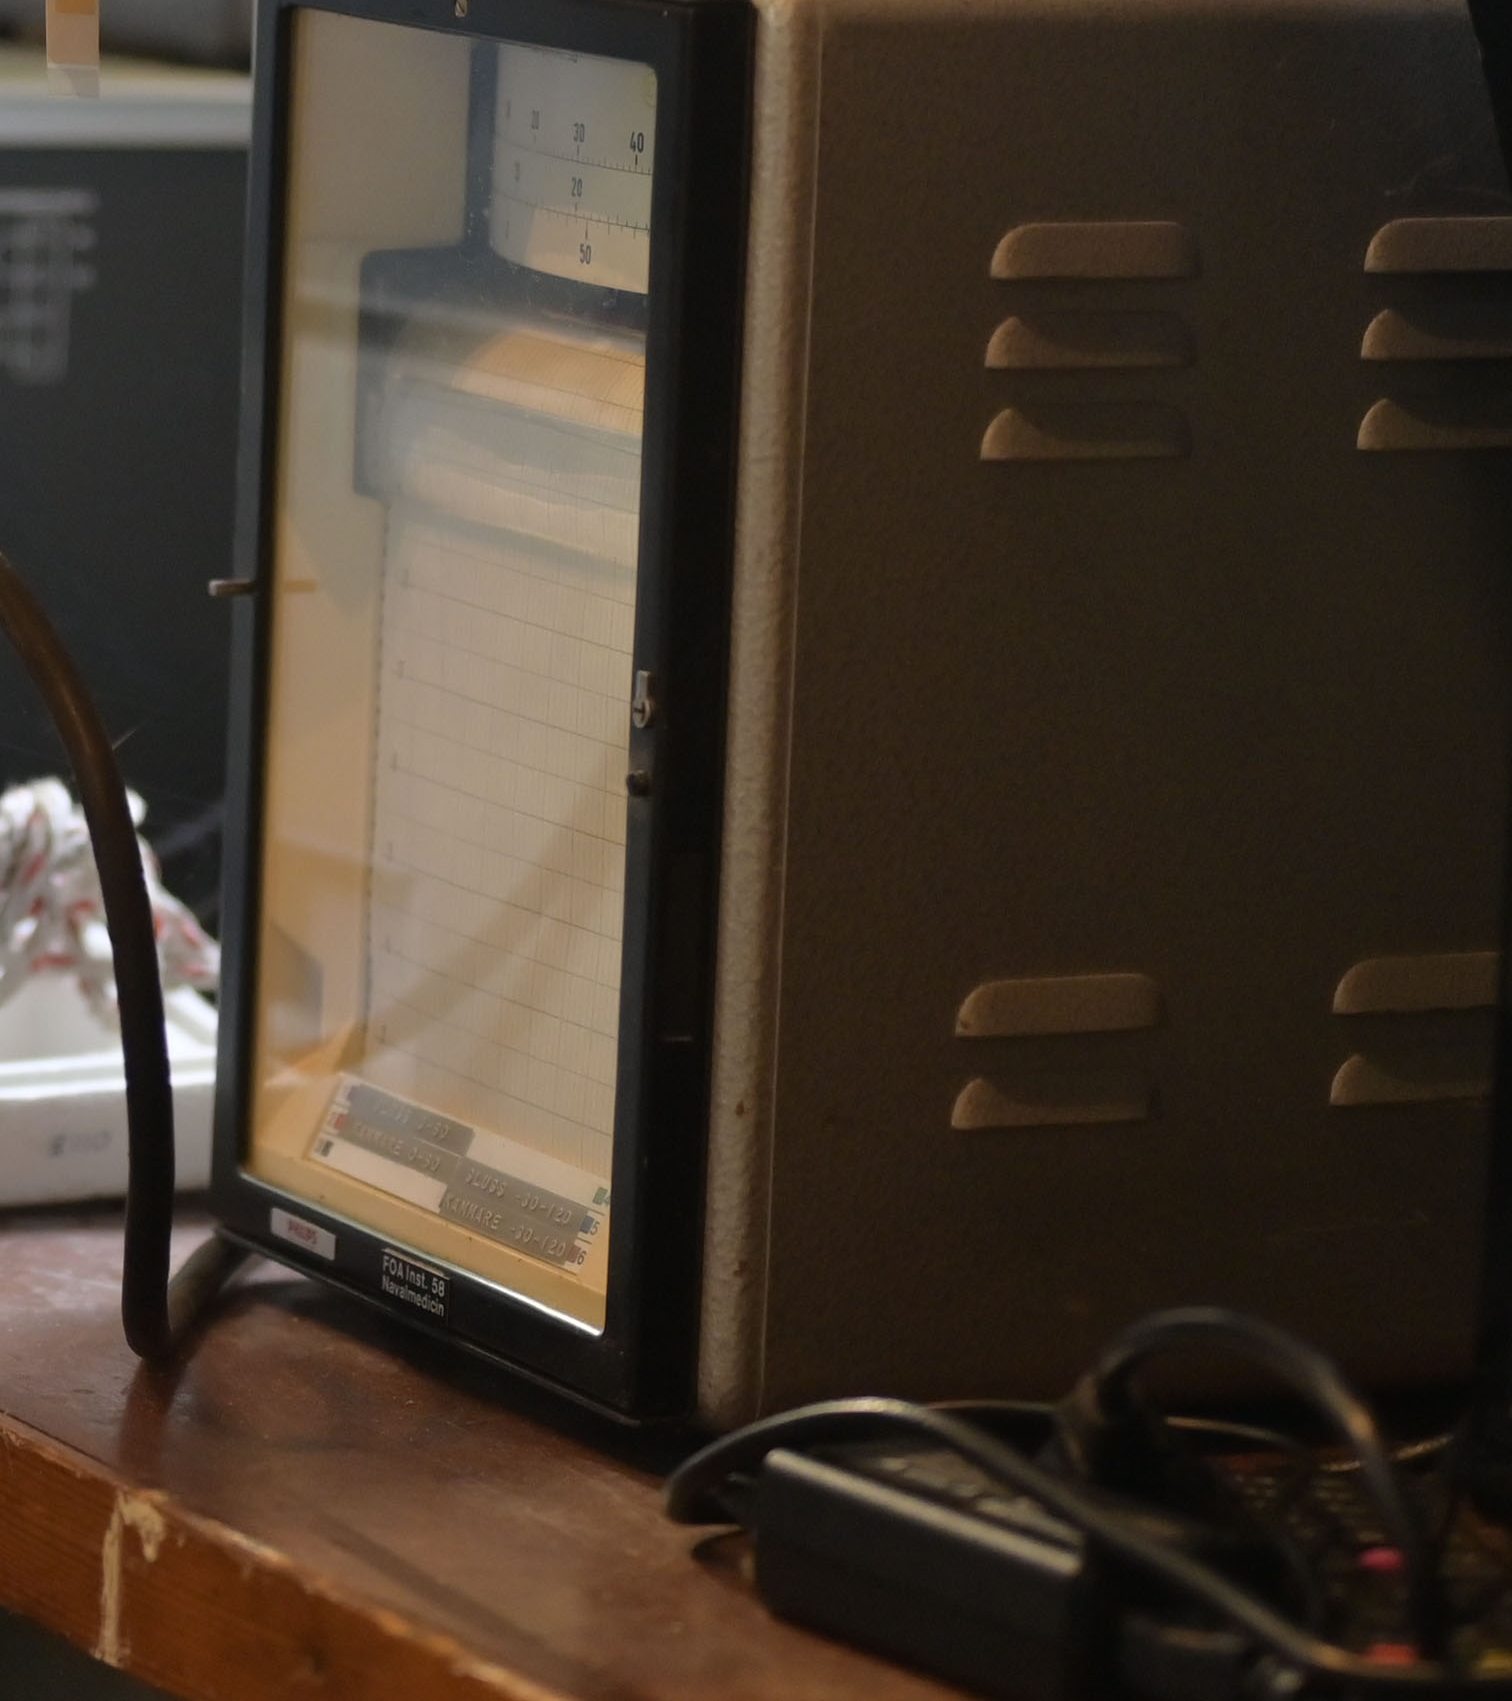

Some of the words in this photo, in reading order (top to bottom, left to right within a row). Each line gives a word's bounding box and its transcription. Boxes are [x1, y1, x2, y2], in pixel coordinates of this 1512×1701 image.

[573, 123, 585, 142] 30
[630, 131, 644, 153] 40
[571, 177, 583, 197] 20
[579, 243, 592, 264] 50
[382, 1255, 404, 1279] FOA
[405, 1264, 428, 1289] Inst.
[431, 1277, 445, 1297] 58
[382, 1274, 445, 1317] Navalmedicin
